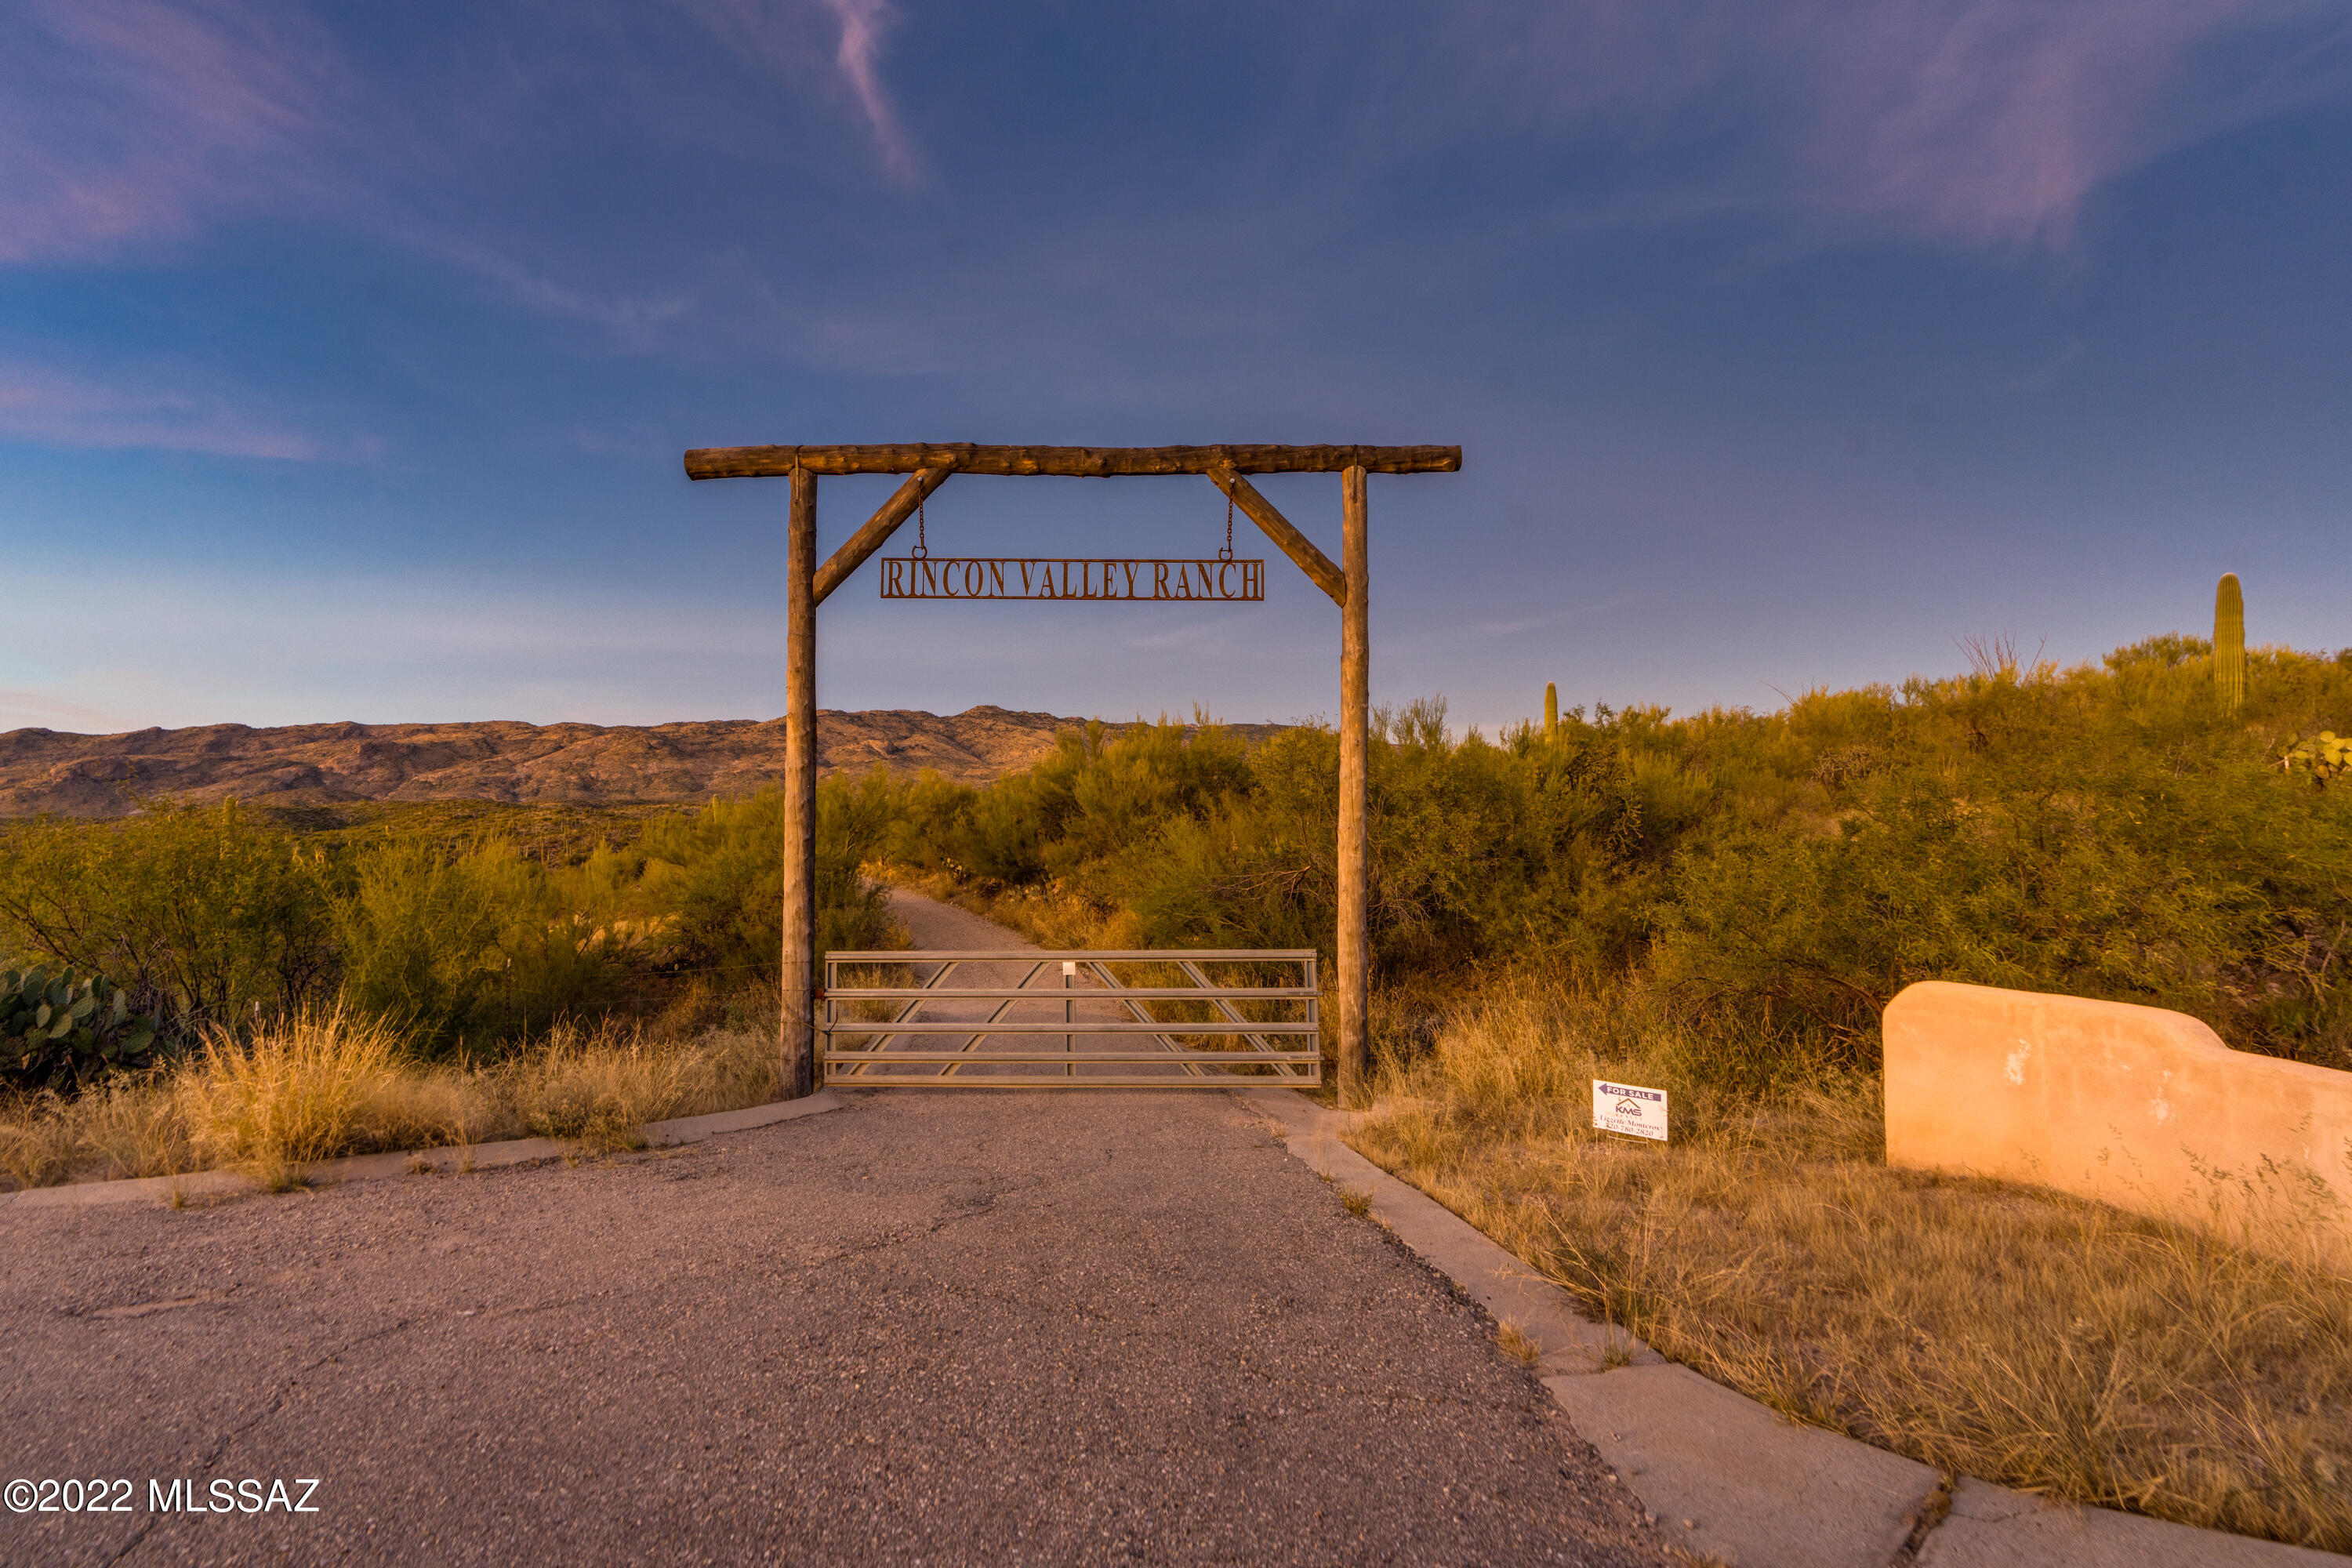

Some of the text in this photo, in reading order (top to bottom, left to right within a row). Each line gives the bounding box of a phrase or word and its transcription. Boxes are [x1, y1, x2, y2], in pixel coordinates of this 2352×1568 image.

[887, 560, 1261, 599] RINCON VALLEY RANCH
[1607, 1087, 1654, 1100] FOR SALE
[1615, 1105, 1642, 1116] KMS
[1606, 1123, 1653, 1137] 20-780-2820
